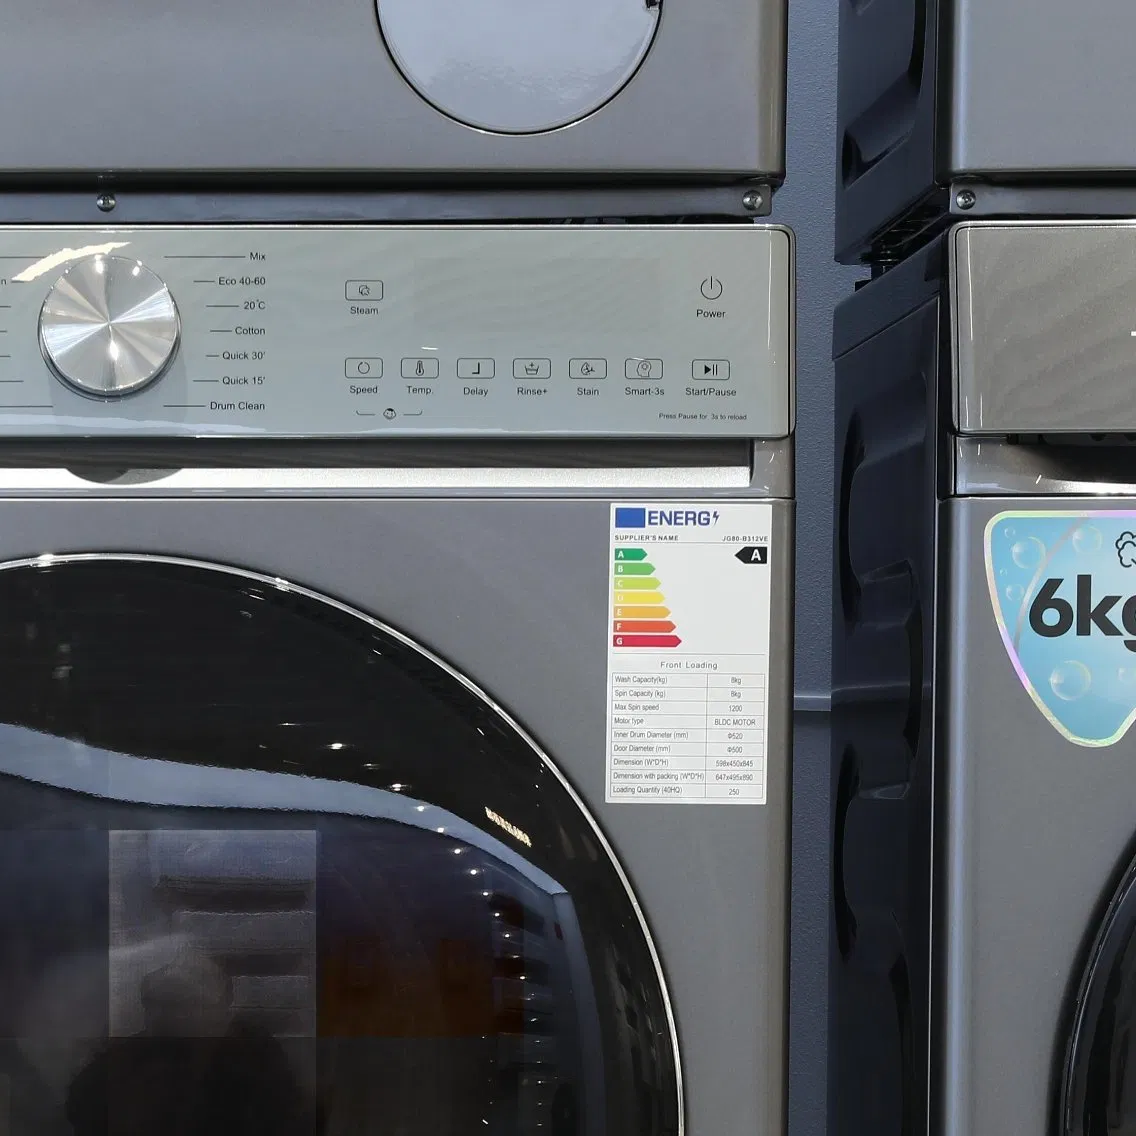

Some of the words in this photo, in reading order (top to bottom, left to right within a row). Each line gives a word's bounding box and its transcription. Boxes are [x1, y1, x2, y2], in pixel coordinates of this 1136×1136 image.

[250, 253, 266, 261] Mix
[218, 277, 236, 286] Eco
[239, 277, 266, 286] 40-60
[350, 306, 379, 315] Steam
[696, 309, 726, 319] Power
[235, 327, 266, 335] Cotton
[222, 351, 248, 361] Quick
[222, 377, 248, 386] Quick
[349, 385, 378, 396] Speed
[406, 385, 434, 397] Temp.
[463, 387, 488, 398] Delay
[517, 387, 548, 396] Rinse+
[577, 387, 599, 396] Stain
[624, 387, 665, 397] Smart-3s
[685, 387, 737, 398] Start/Pause
[210, 402, 235, 410] Drum
[238, 402, 265, 410] Clean
[648, 511, 711, 526] ENERG
[618, 550, 624, 559] A
[751, 550, 761, 561] A
[685, 662, 718, 670] Loading
[614, 690, 627, 698] Spin
[655, 690, 666, 698] (kg)
[674, 731, 688, 739] (mm)
[657, 773, 679, 781] packing
[613, 786, 635, 794] Loading
[637, 786, 660, 794] Quantity
